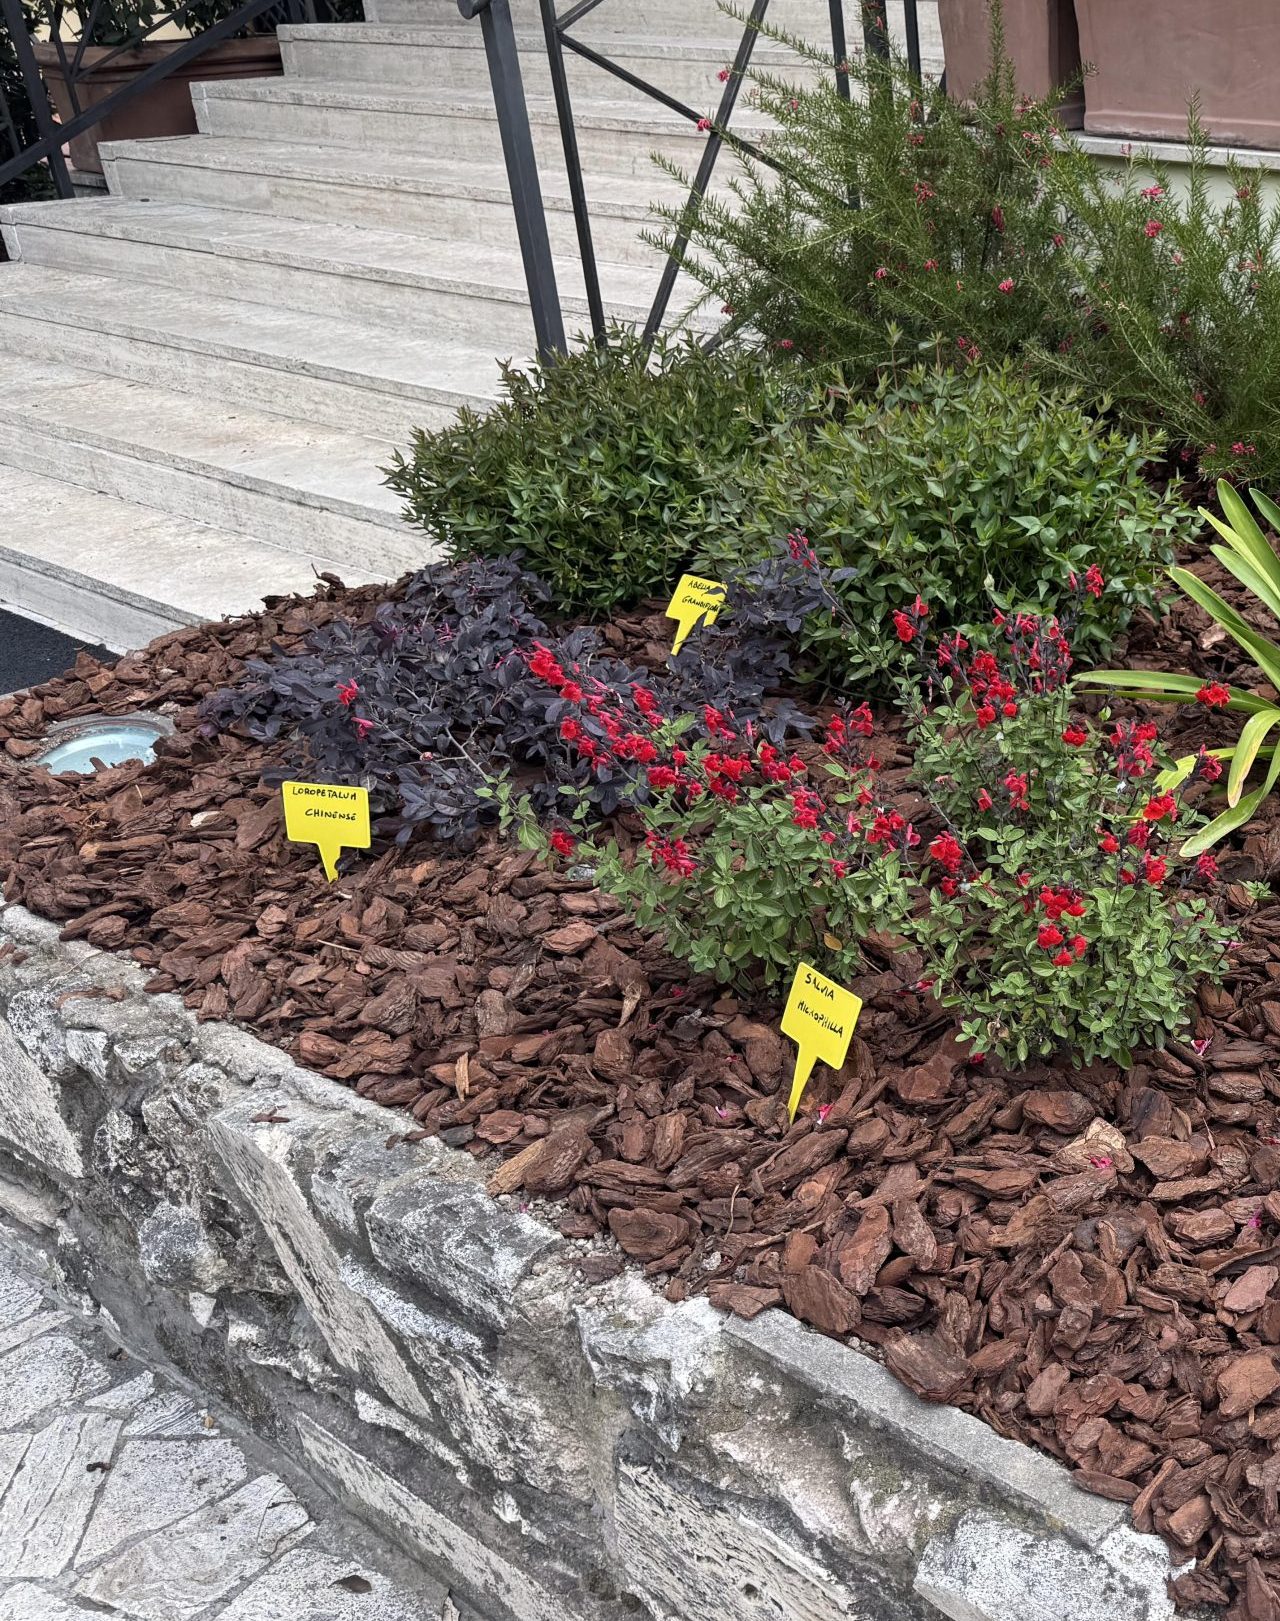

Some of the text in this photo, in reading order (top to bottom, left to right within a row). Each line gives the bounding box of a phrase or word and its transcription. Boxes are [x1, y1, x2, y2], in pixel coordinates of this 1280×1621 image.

[292, 786, 357, 800] LOROPETALUM
[305, 808, 357, 821] CHINENSE
[805, 973, 835, 1001] SALVIA
